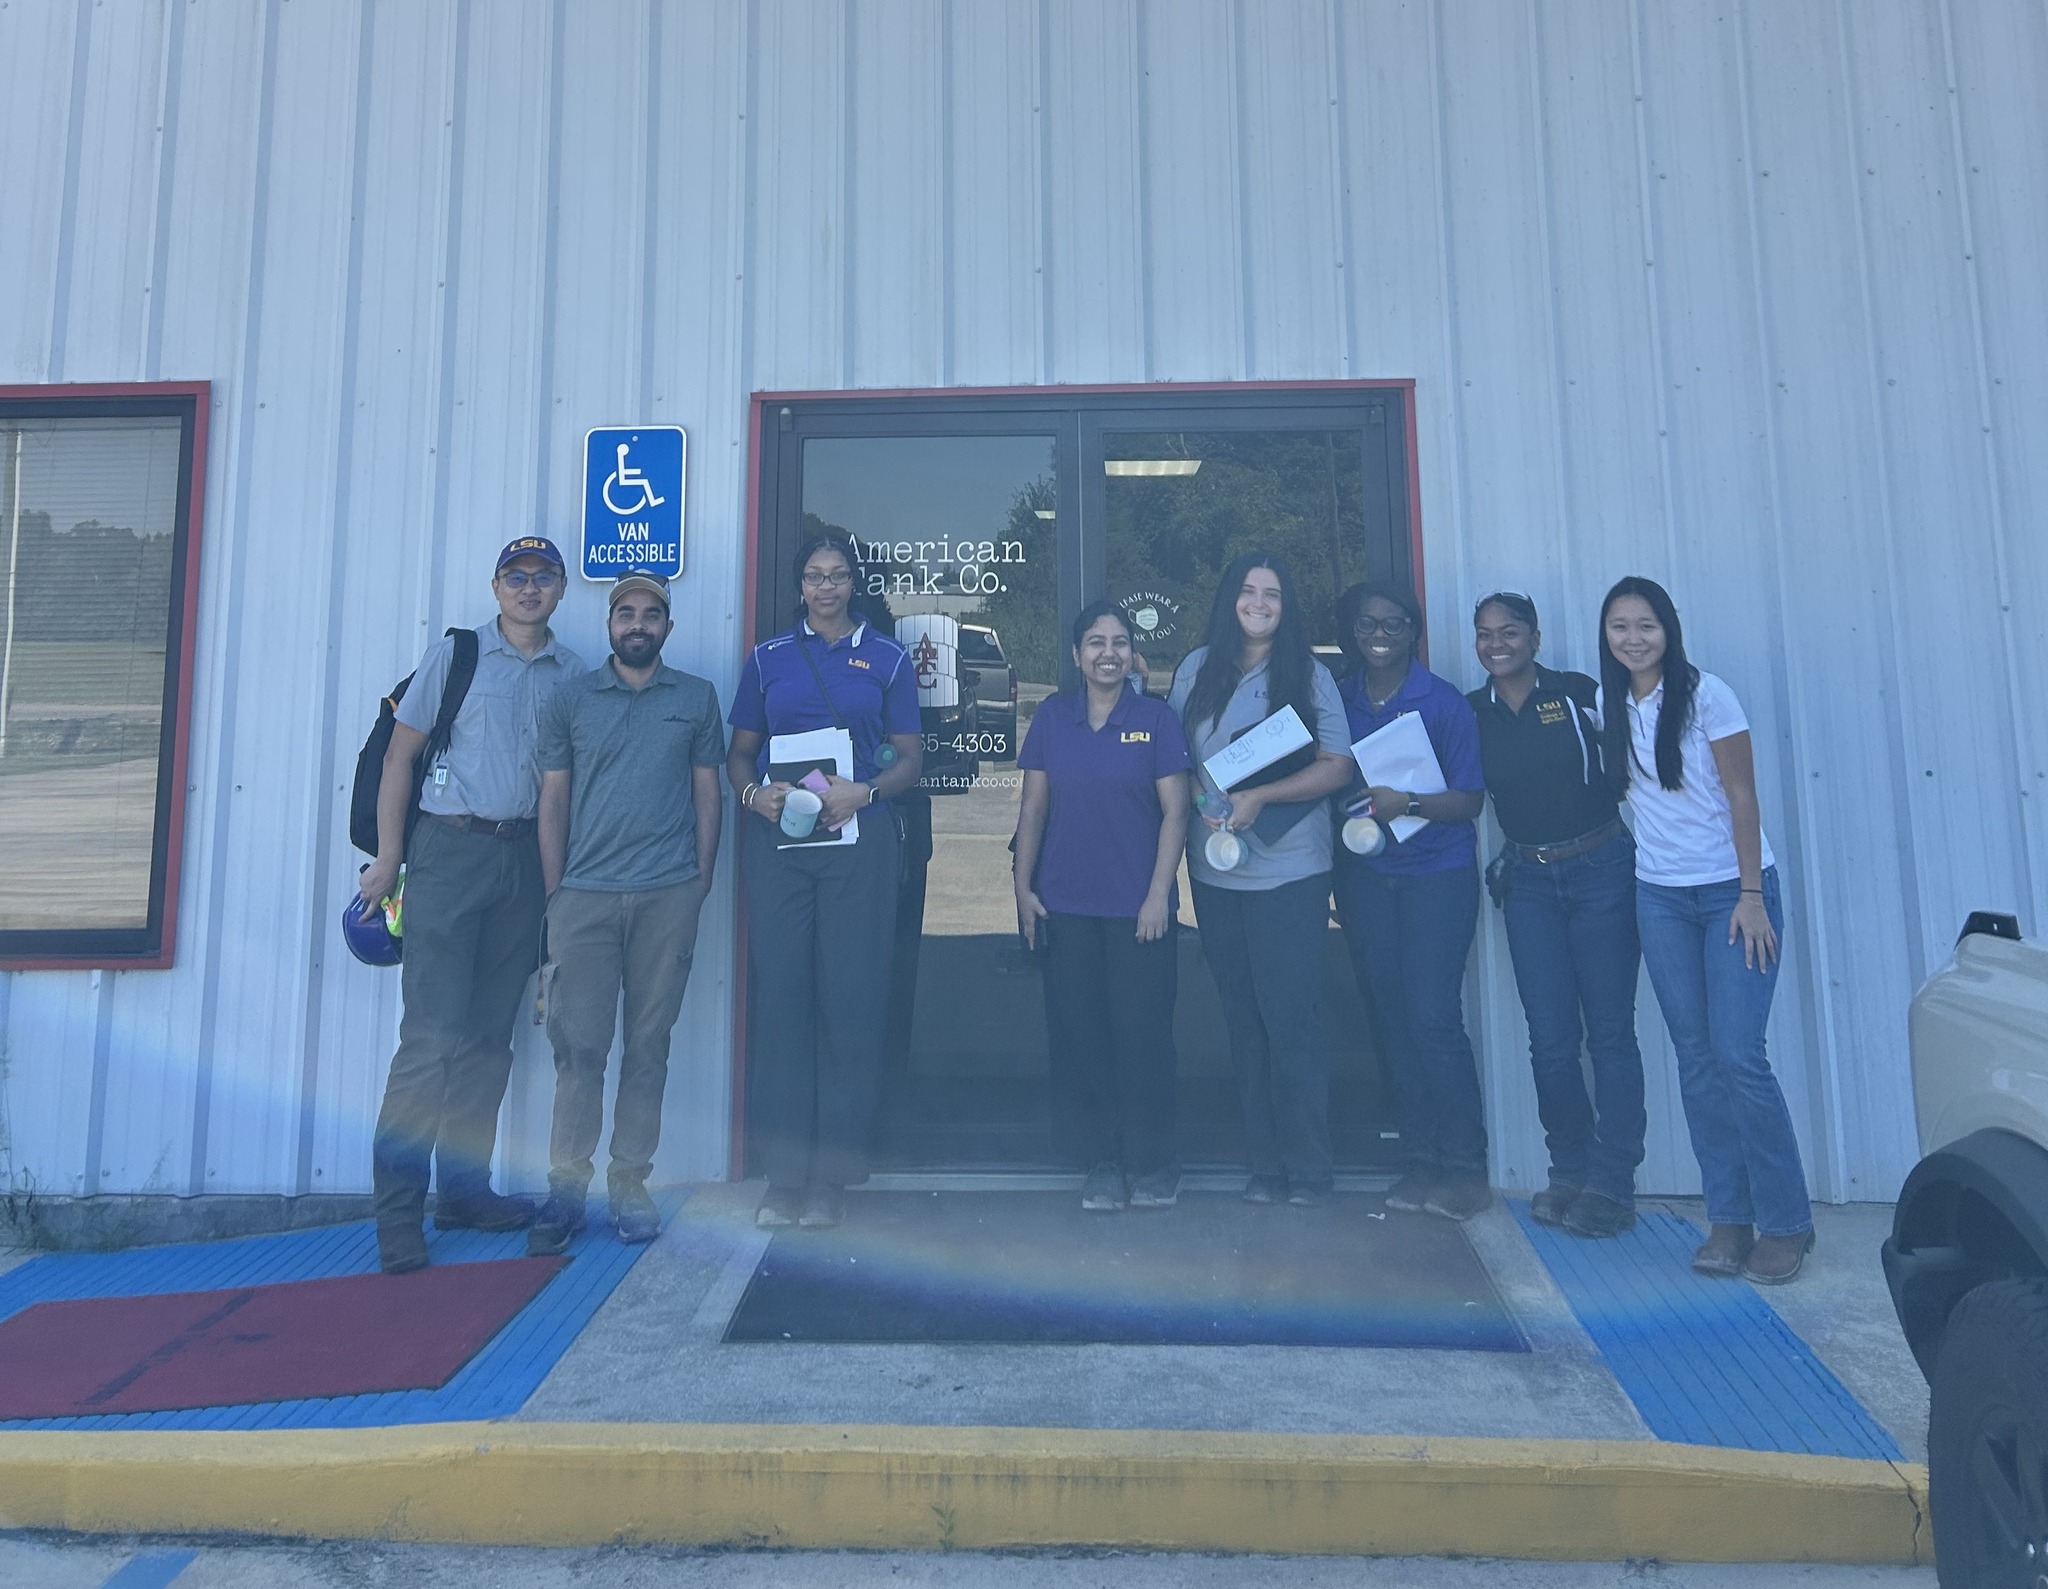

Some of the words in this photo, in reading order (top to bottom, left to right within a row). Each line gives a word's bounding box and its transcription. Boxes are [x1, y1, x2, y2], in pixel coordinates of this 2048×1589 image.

[617, 522, 649, 541] VAN
[510, 539, 546, 552] LSU
[588, 543, 676, 563] ACCESSIBLE
[848, 533, 1026, 563] American
[959, 564, 1007, 594] Co.
[1119, 592, 1142, 609] LEASE
[1144, 591, 1171, 608] WEAR
[1170, 604, 1179, 614] A
[848, 658, 870, 670] LSU
[1254, 690, 1268, 699] LS
[1536, 700, 1561, 712] LSU
[1120, 731, 1151, 743] LSU
